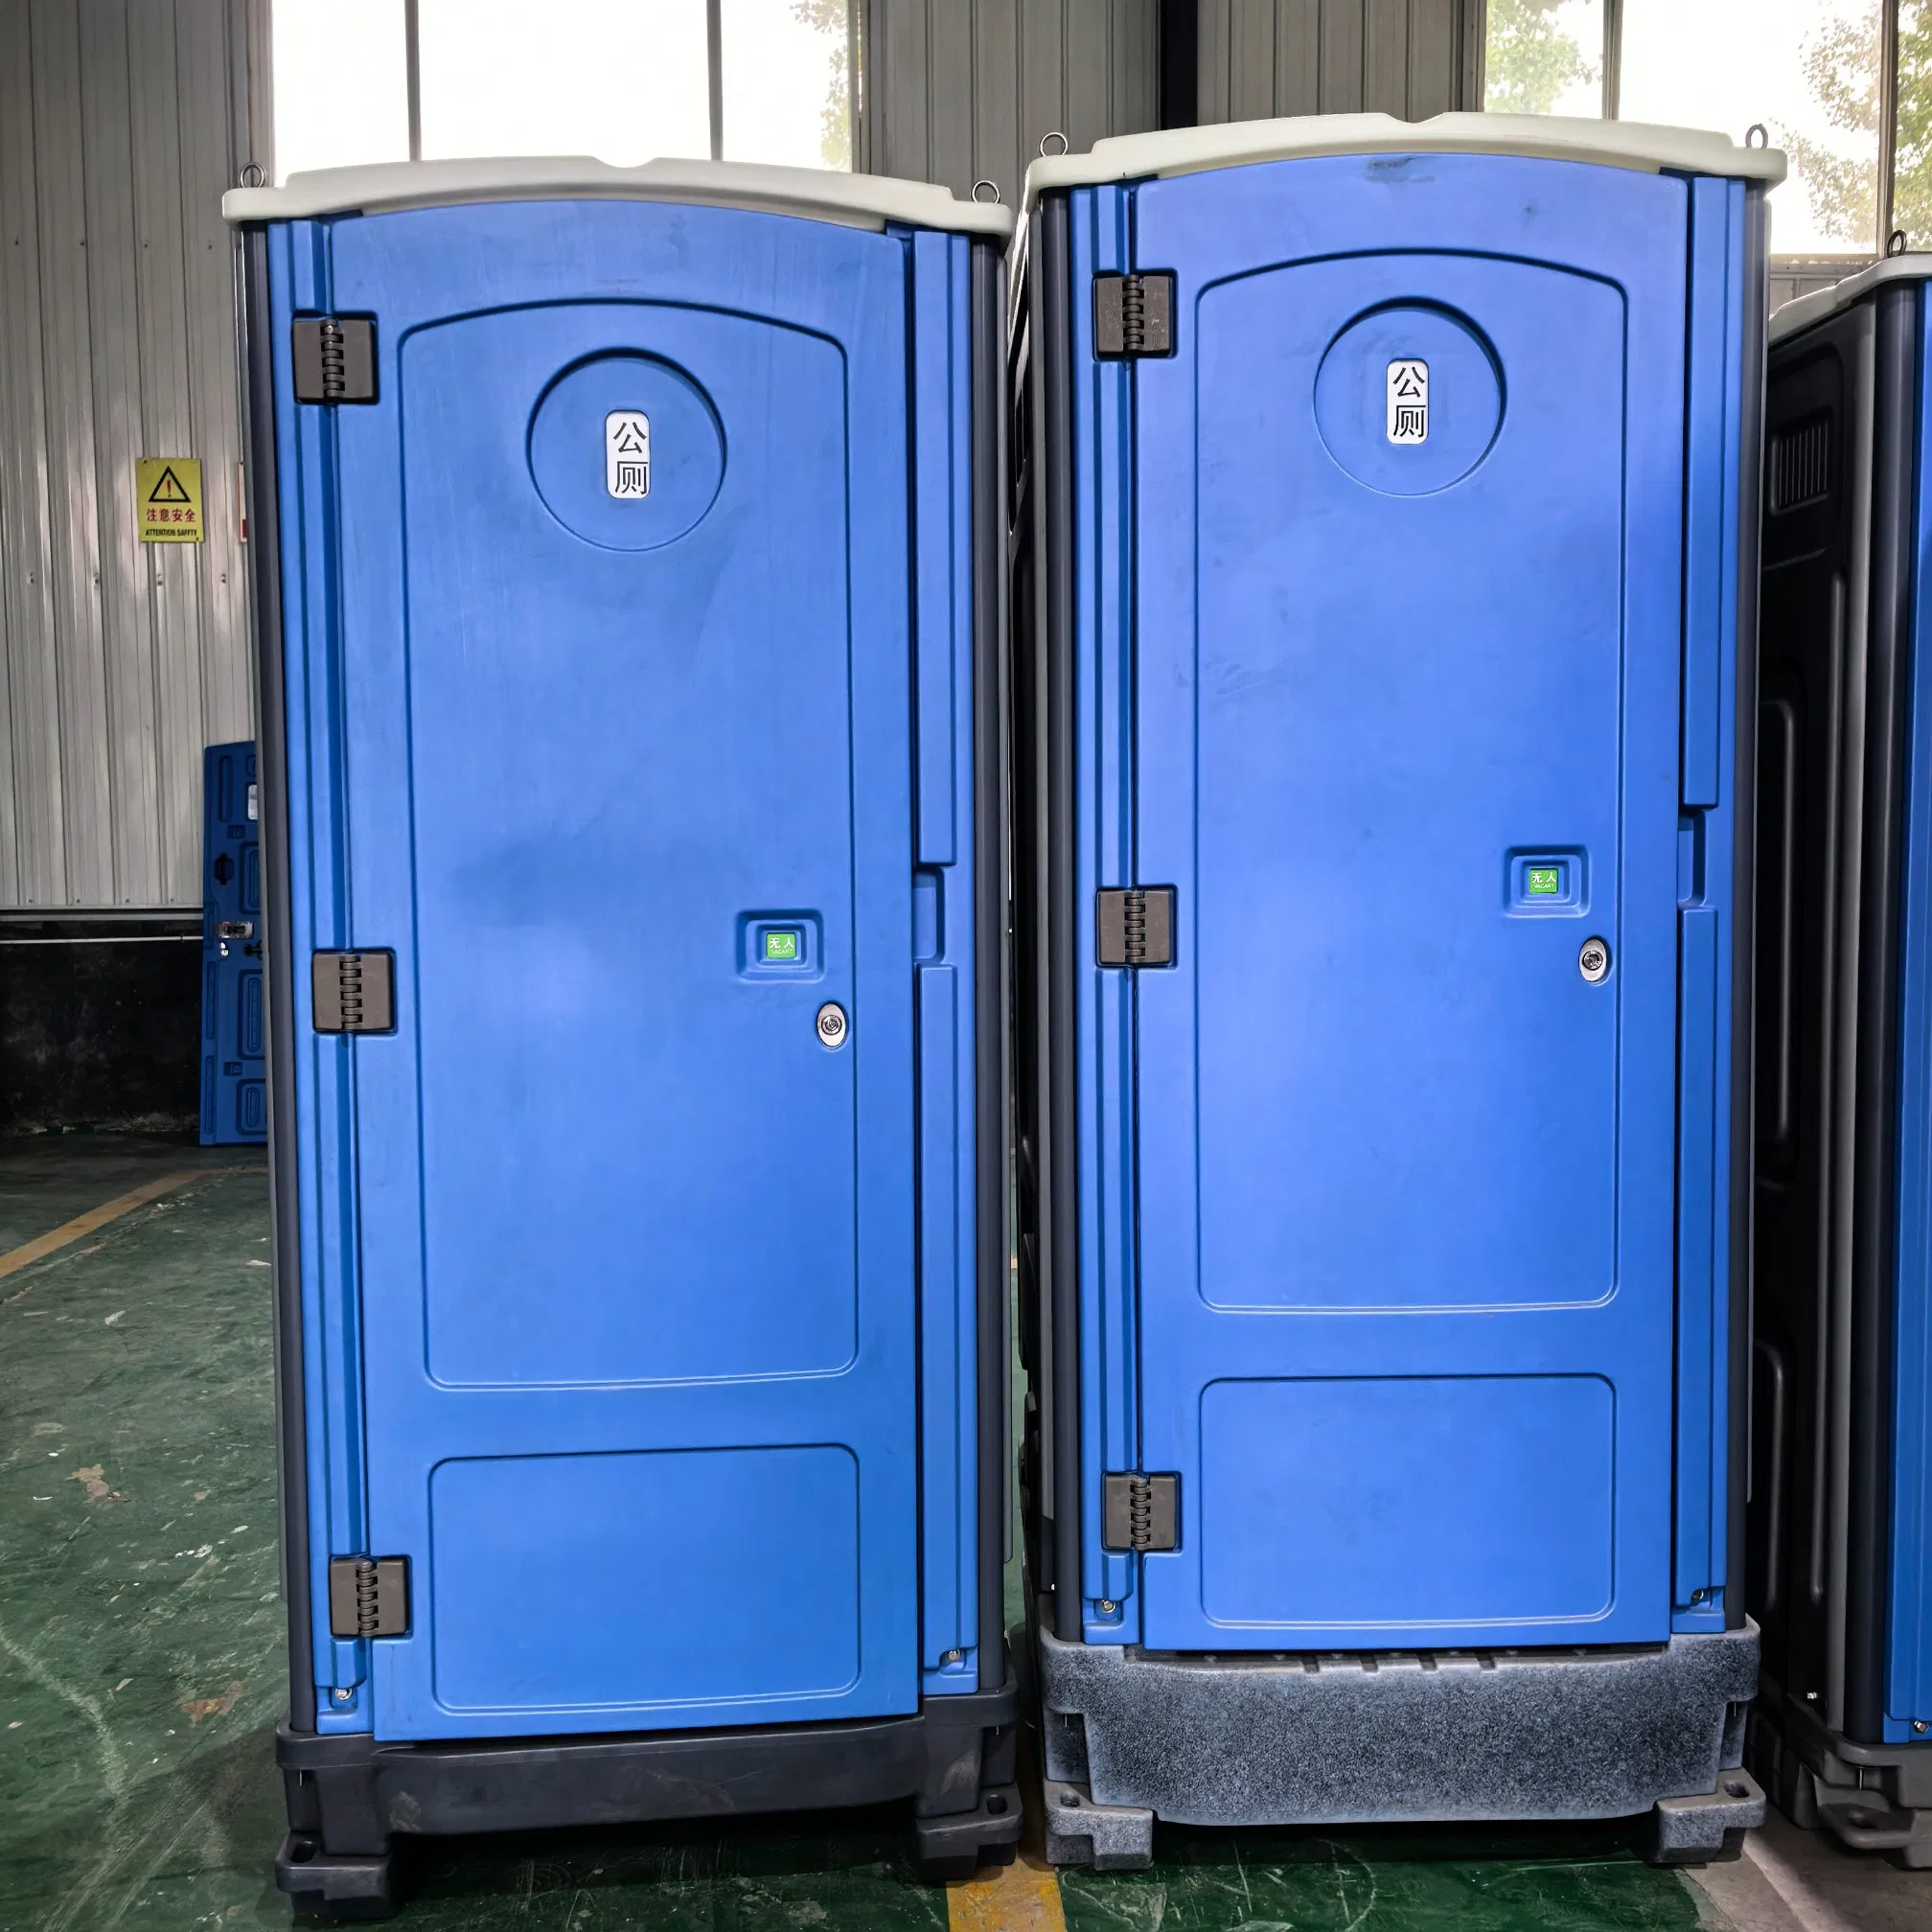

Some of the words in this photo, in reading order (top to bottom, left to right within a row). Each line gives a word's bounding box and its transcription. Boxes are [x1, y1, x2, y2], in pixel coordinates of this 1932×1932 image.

[1392, 366, 1427, 438] 公厕
[612, 422, 649, 495] 公厕
[147, 508, 196, 522] 注意安全
[1531, 872, 1557, 883] 无人
[769, 937, 794, 949] 无人
